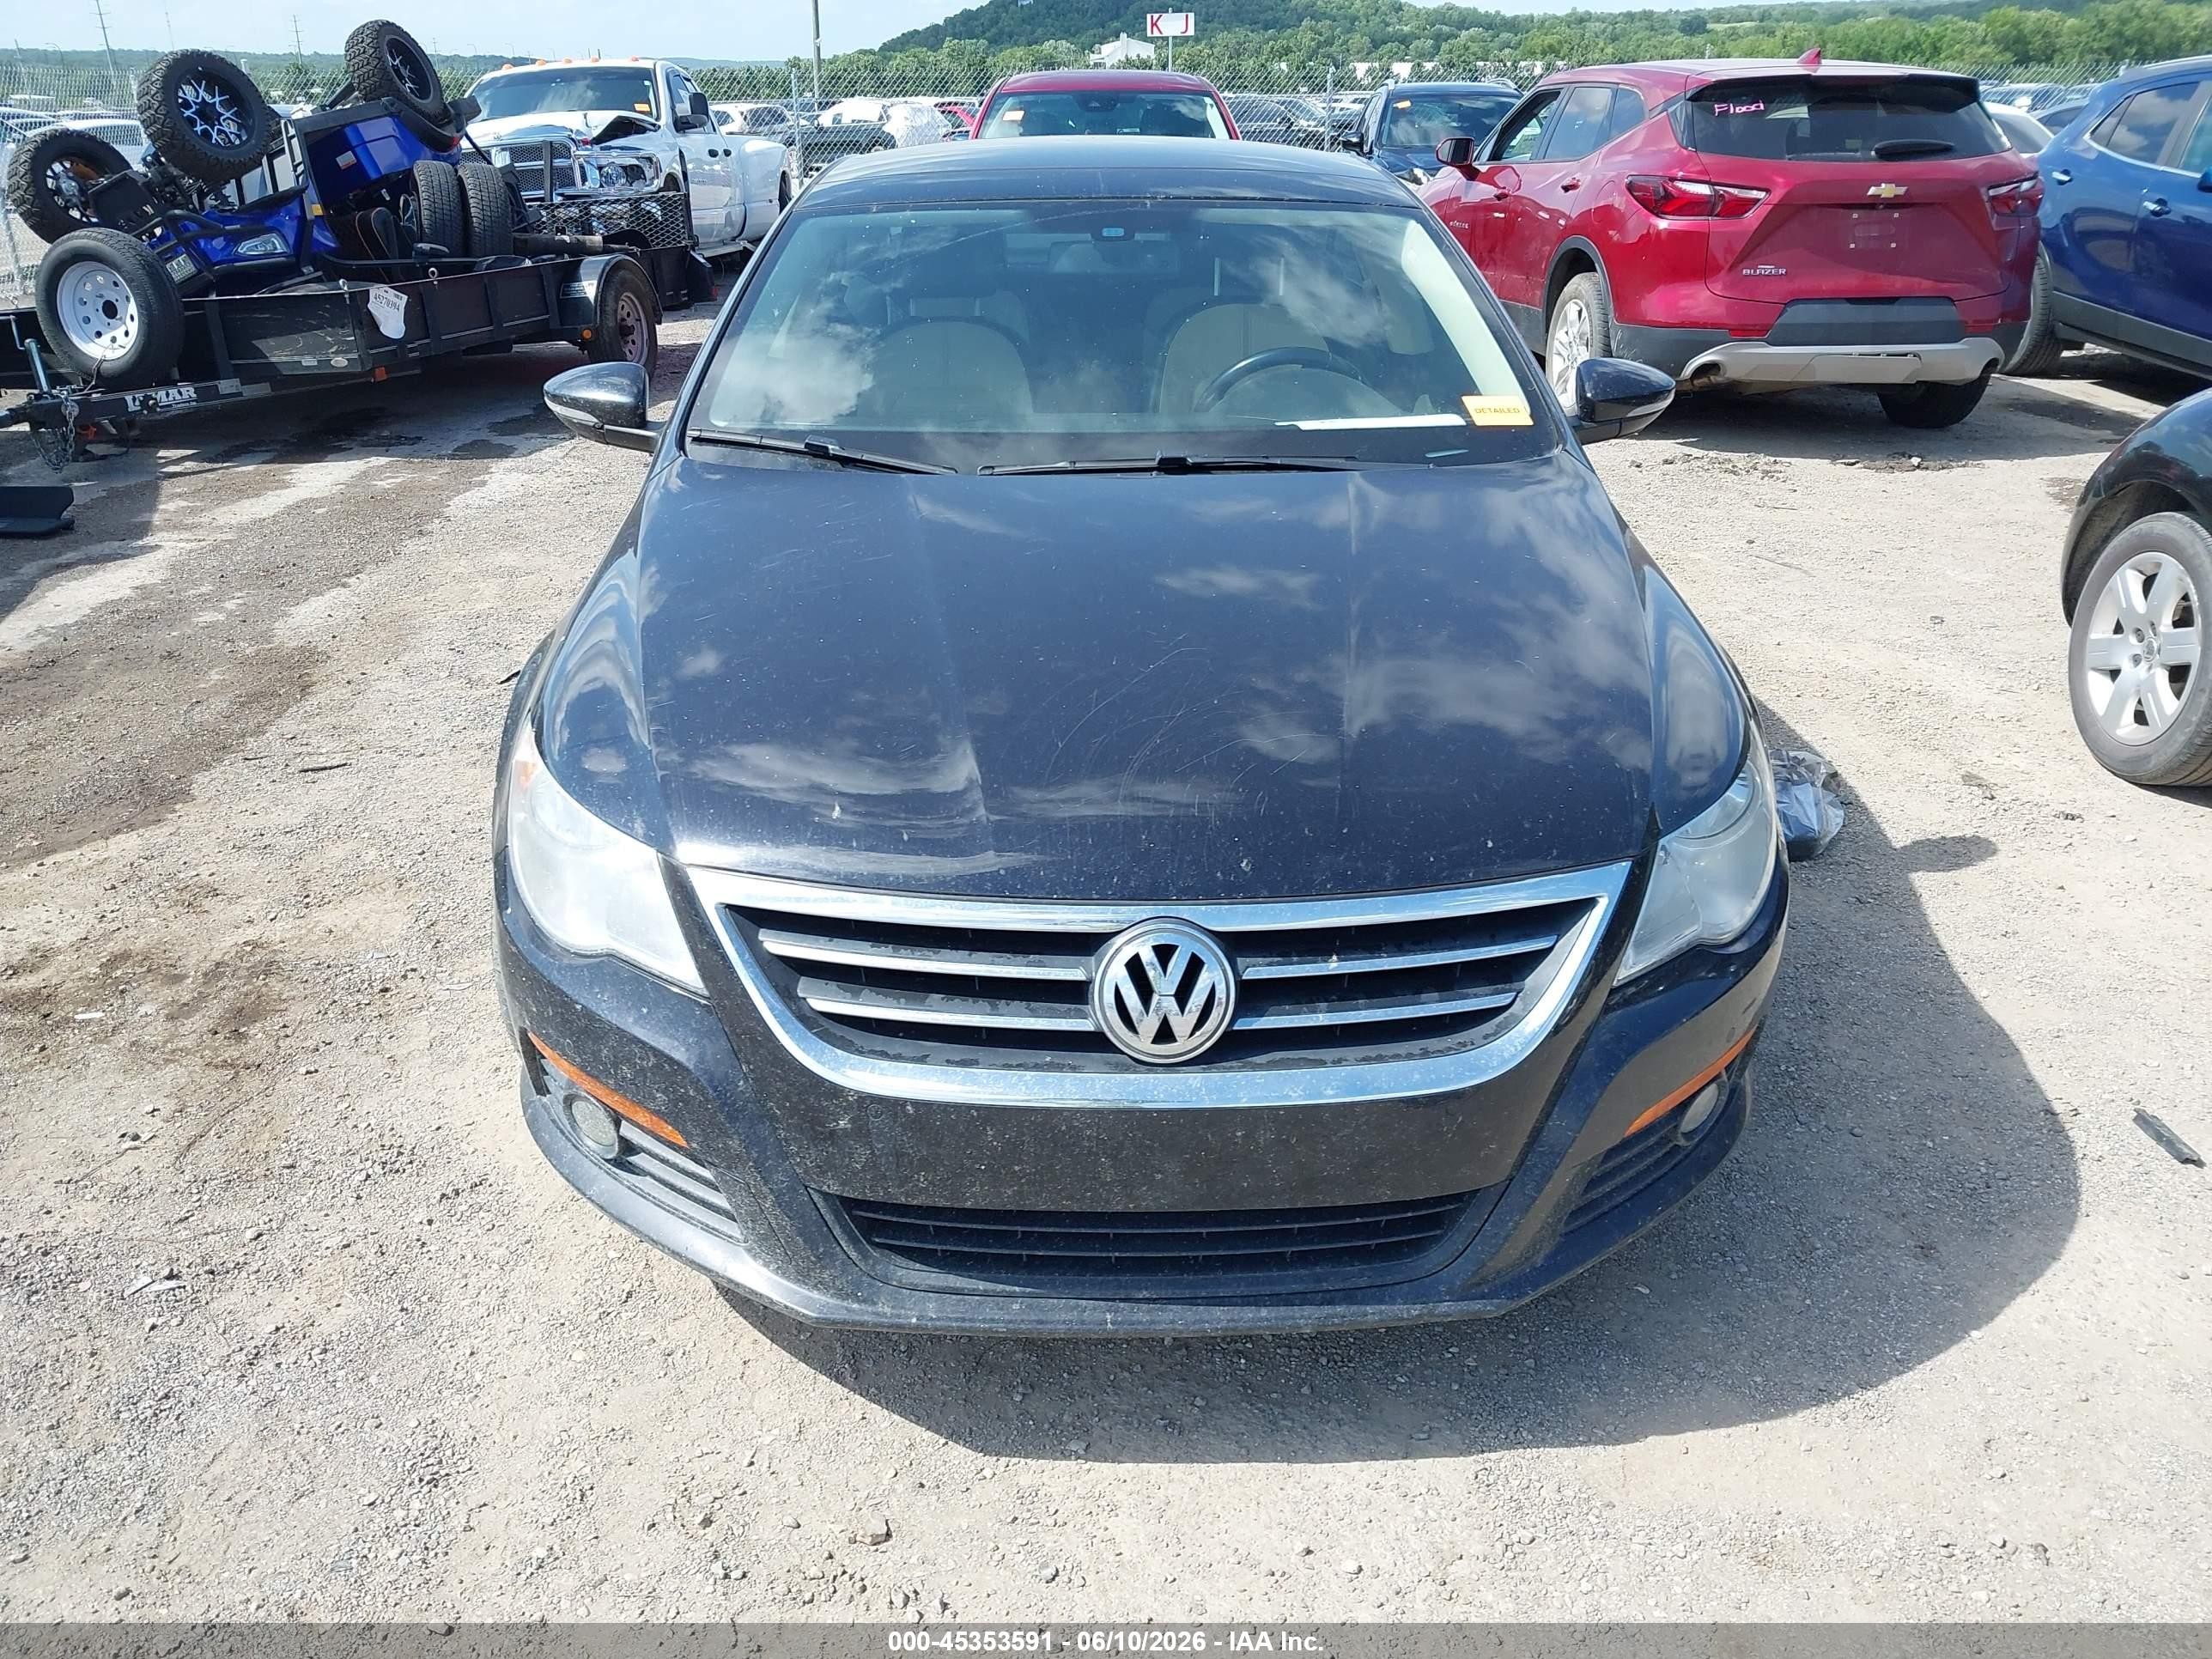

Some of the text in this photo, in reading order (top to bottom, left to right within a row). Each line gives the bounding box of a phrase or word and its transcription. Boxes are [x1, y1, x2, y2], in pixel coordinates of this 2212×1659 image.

[1150, 13, 1189, 35] K J
[1714, 100, 1765, 116] Flood
